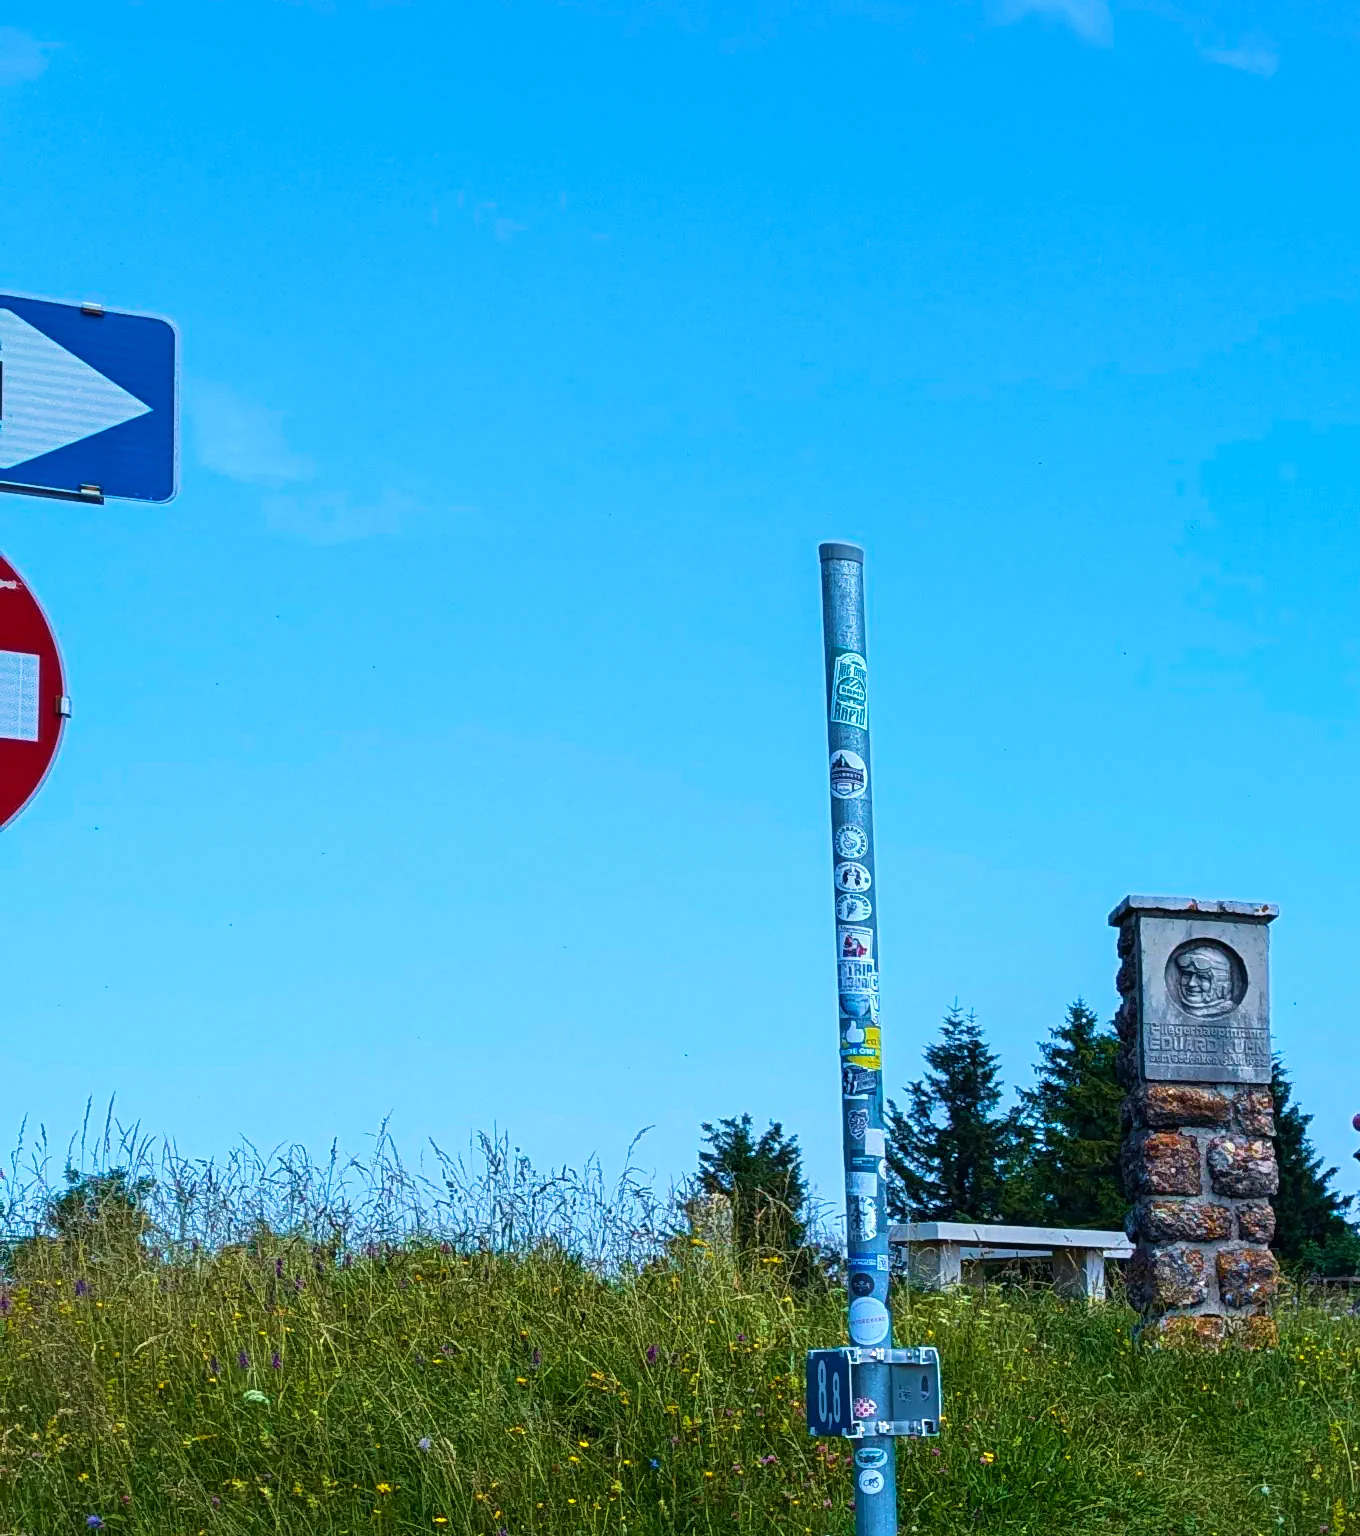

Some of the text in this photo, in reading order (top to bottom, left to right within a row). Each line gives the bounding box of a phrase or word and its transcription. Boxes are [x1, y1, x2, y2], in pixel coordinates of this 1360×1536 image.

[834, 702, 866, 726] RAPID
[1149, 1036, 1217, 1054] EDUARD
[817, 1359, 841, 1430] 8,8
